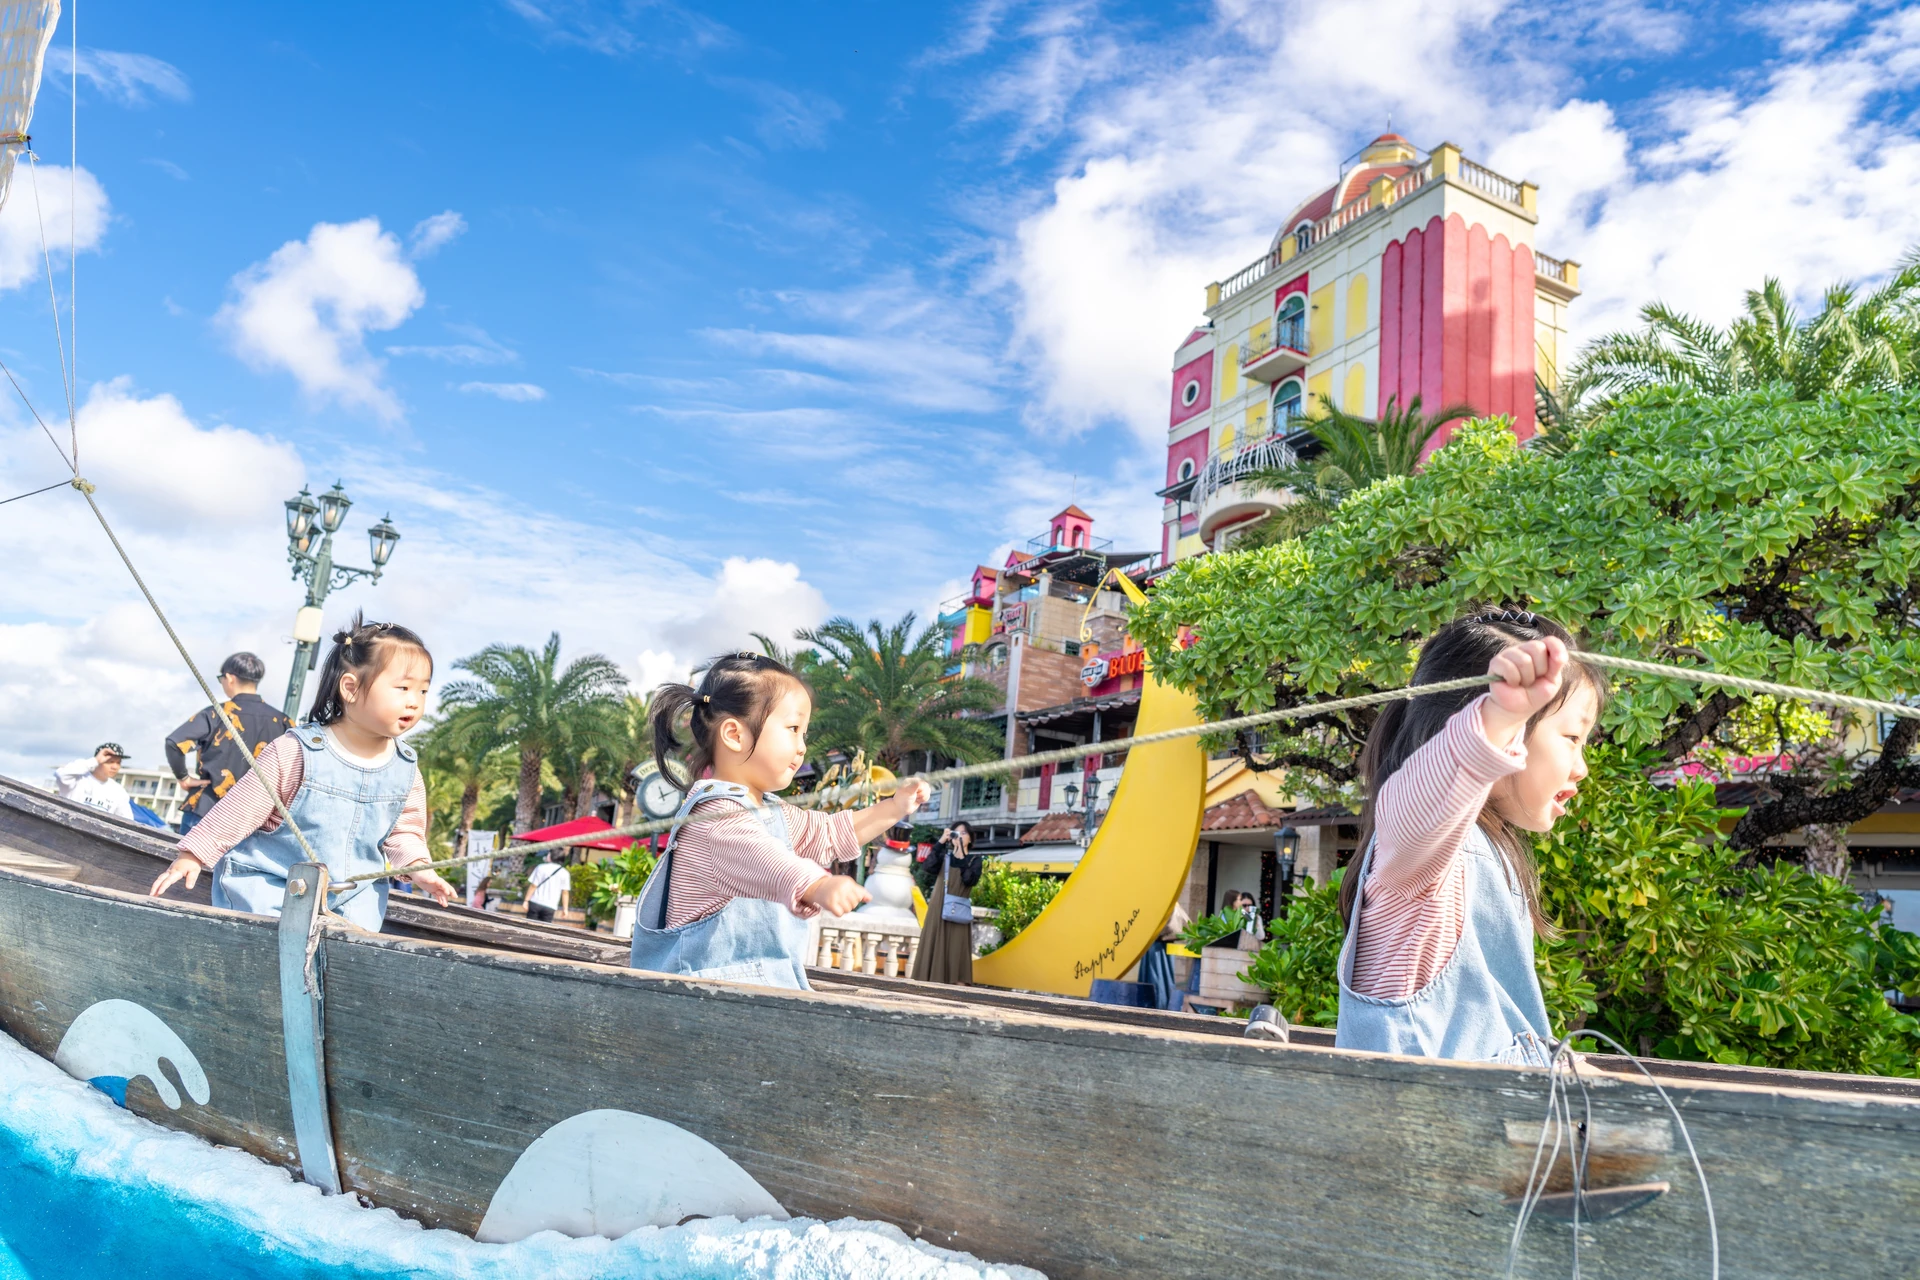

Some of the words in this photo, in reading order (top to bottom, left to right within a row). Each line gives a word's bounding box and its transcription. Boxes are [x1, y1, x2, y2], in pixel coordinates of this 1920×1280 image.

[1109, 650, 1144, 678] BLUE
[1074, 946, 1116, 979] Happy
[1113, 908, 1141, 947] Luna
